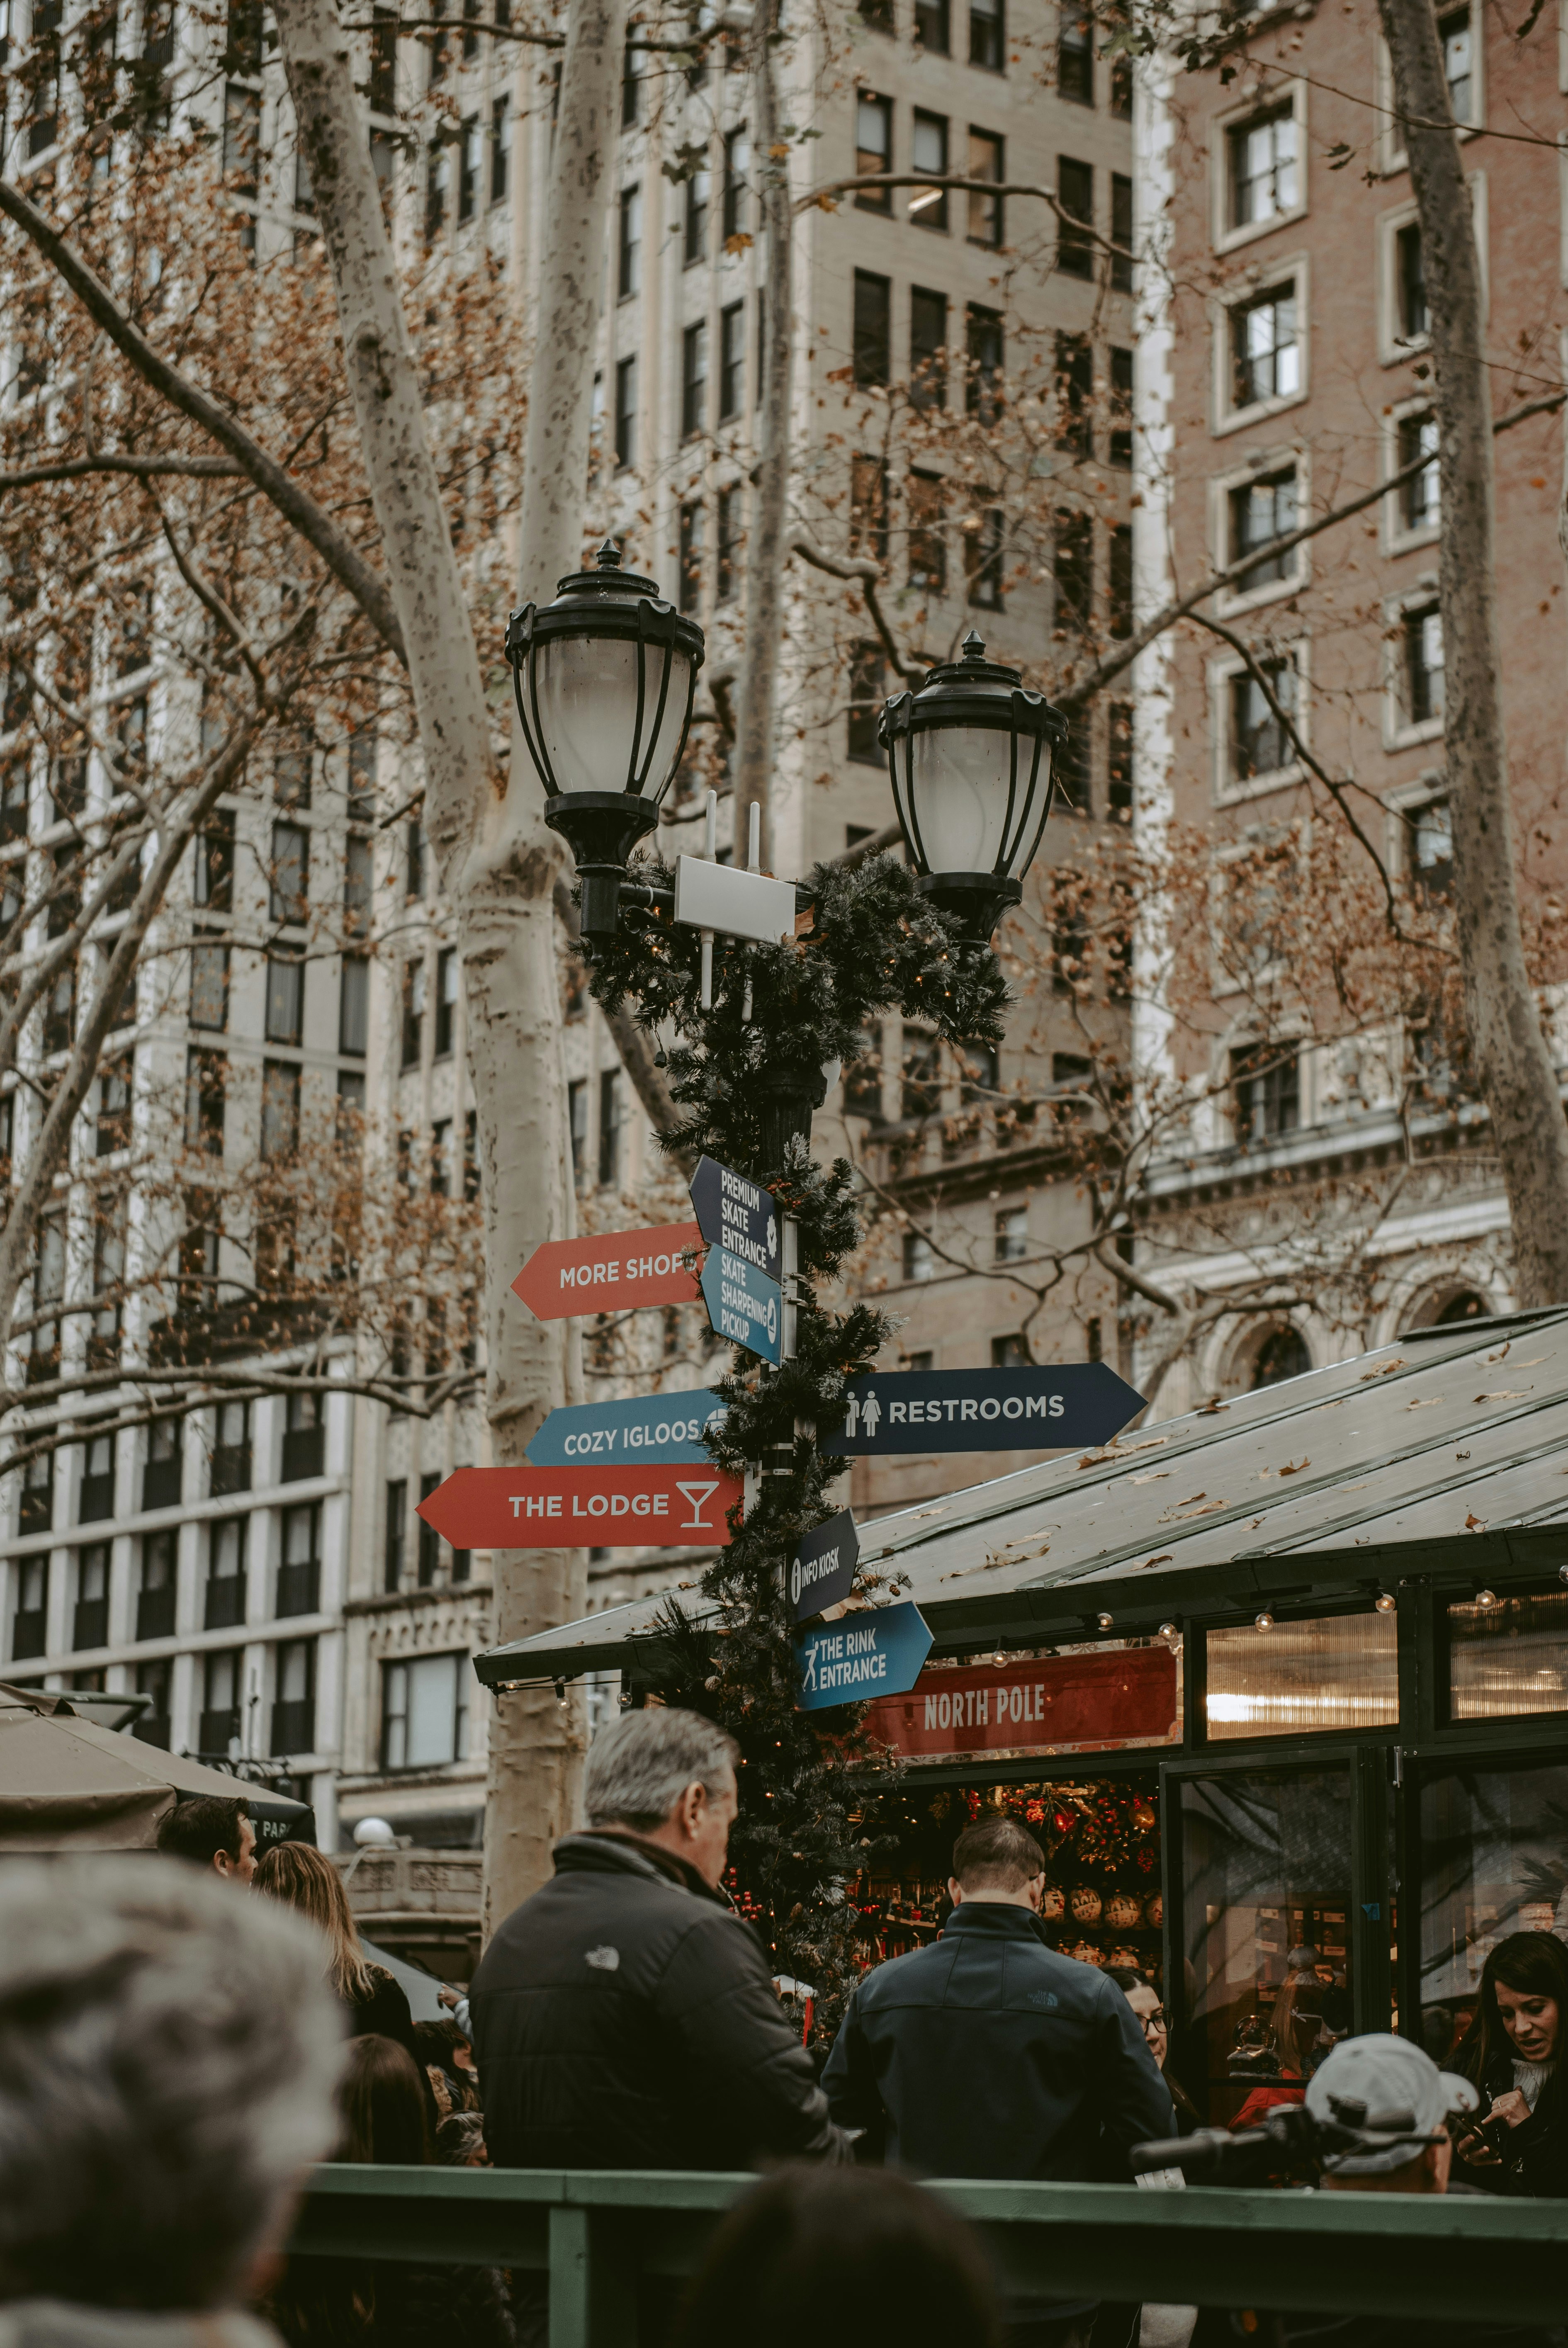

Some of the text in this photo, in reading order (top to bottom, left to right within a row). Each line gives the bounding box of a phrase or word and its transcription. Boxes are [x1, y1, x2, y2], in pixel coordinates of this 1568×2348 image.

[722, 1169, 759, 1212] PREMIUM
[722, 1198, 749, 1232] SKATE
[722, 1225, 767, 1269] ENTRANCE
[560, 1261, 619, 1288] MORE
[722, 1253, 746, 1286] SKATE
[722, 1281, 767, 1327] SHARPENING
[722, 1308, 749, 1342] PICKUP
[890, 1395, 1065, 1423] RESTROOMS
[564, 1419, 699, 1455] COZY IGLOOS
[509, 1494, 669, 1517] THE LODGE
[802, 1546, 839, 1588] INFO KIOSK
[819, 1628, 876, 1660] THE RINK
[819, 1654, 886, 1690] ENTRANCE
[924, 1684, 1045, 1731] NORTH POLE
